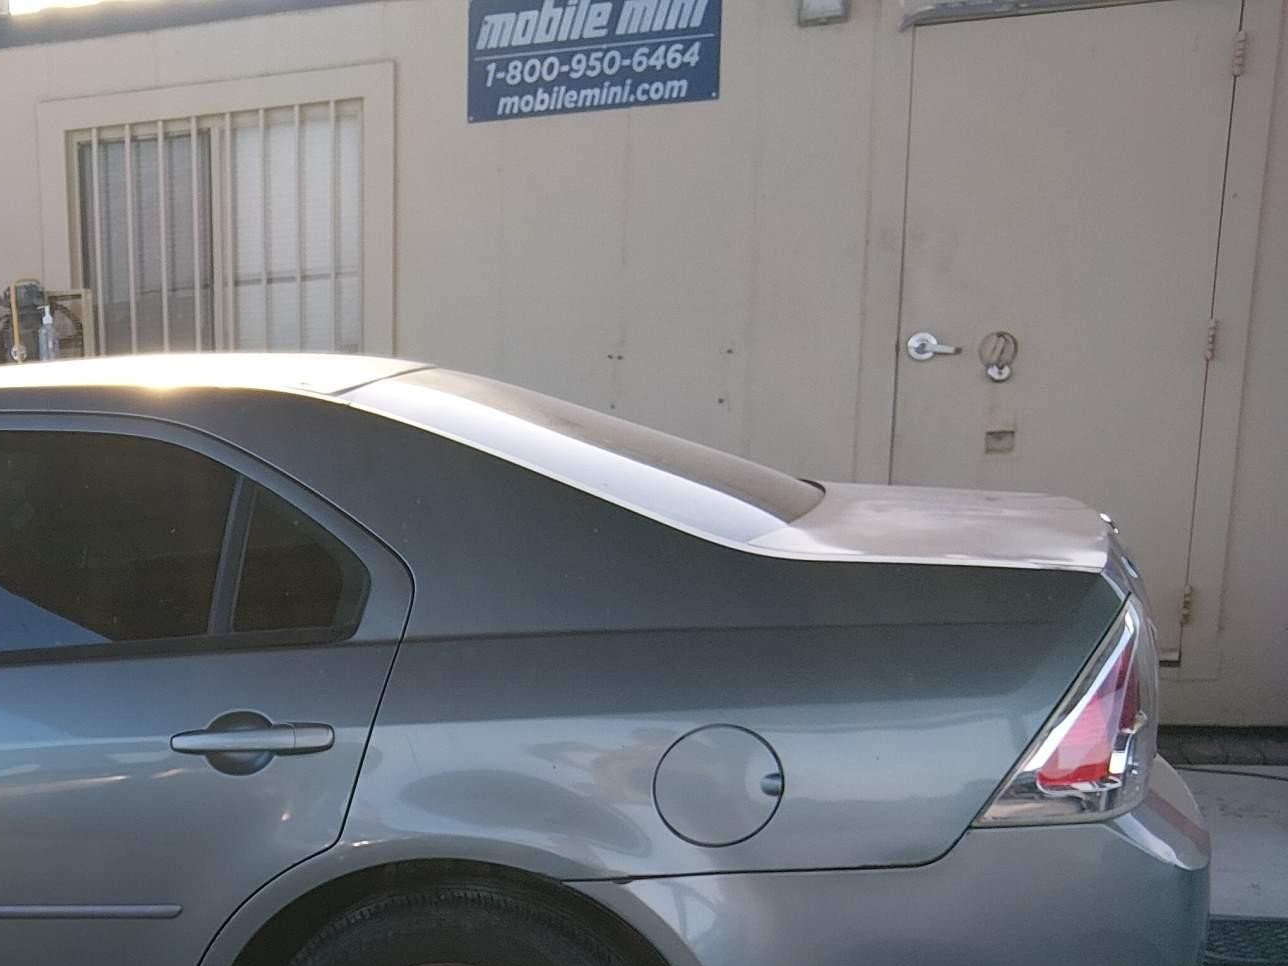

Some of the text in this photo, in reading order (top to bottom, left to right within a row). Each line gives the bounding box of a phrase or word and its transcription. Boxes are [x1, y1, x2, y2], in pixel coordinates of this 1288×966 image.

[476, 0, 709, 49] mobile mini
[485, 42, 700, 87] 1-800-950-6464
[497, 77, 688, 115] mobilemini.com
